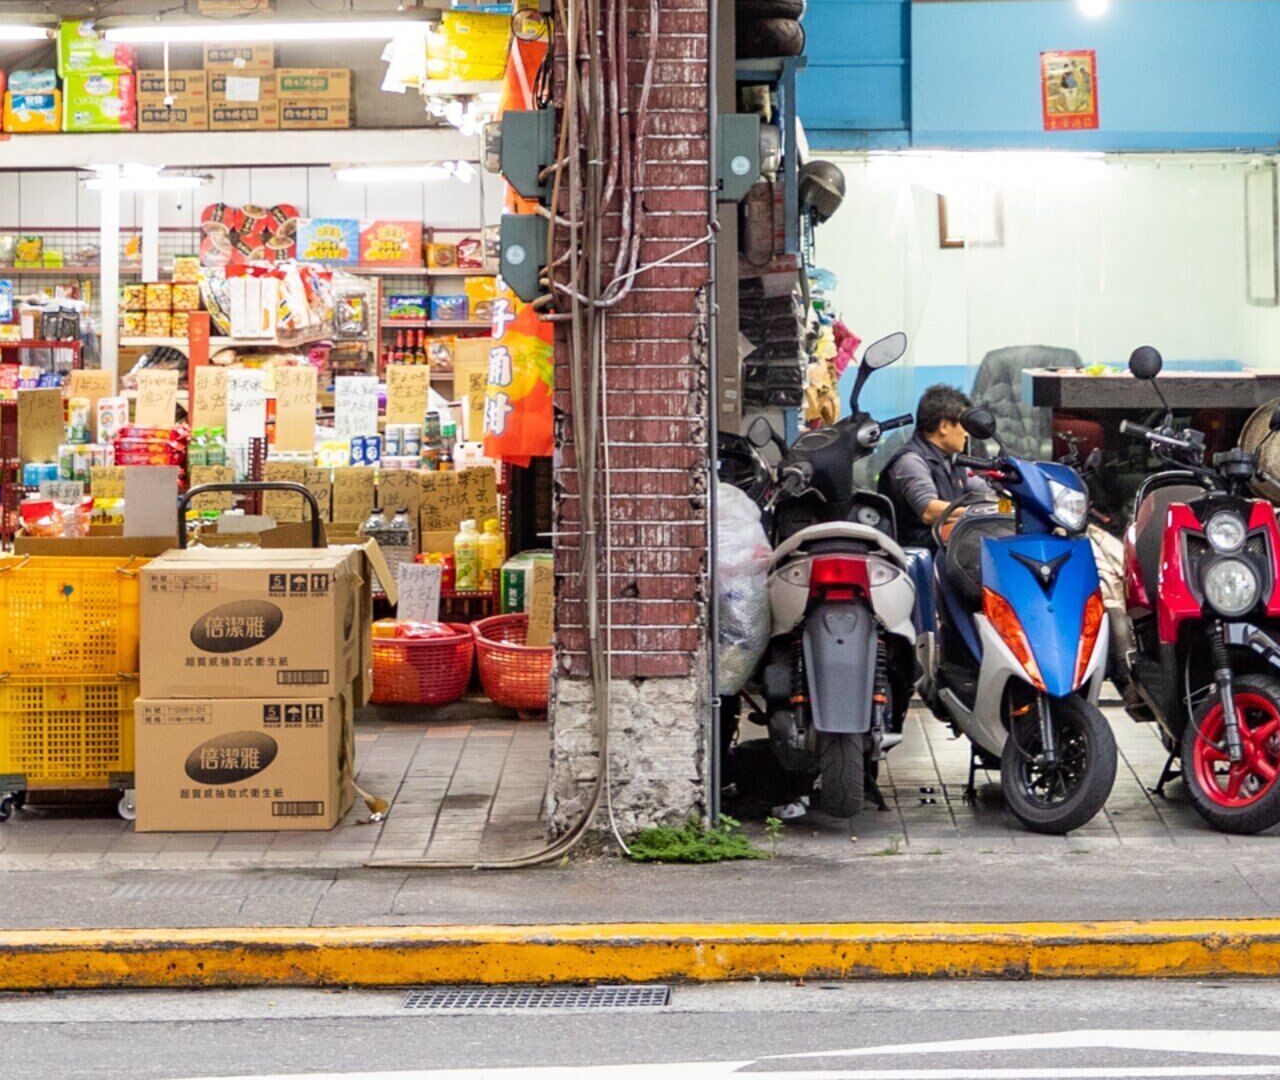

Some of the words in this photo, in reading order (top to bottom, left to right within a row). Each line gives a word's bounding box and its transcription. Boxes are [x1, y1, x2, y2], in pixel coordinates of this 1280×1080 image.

[204, 616, 266, 639] 倍潔雅
[199, 747, 261, 770] 倍潔雅
